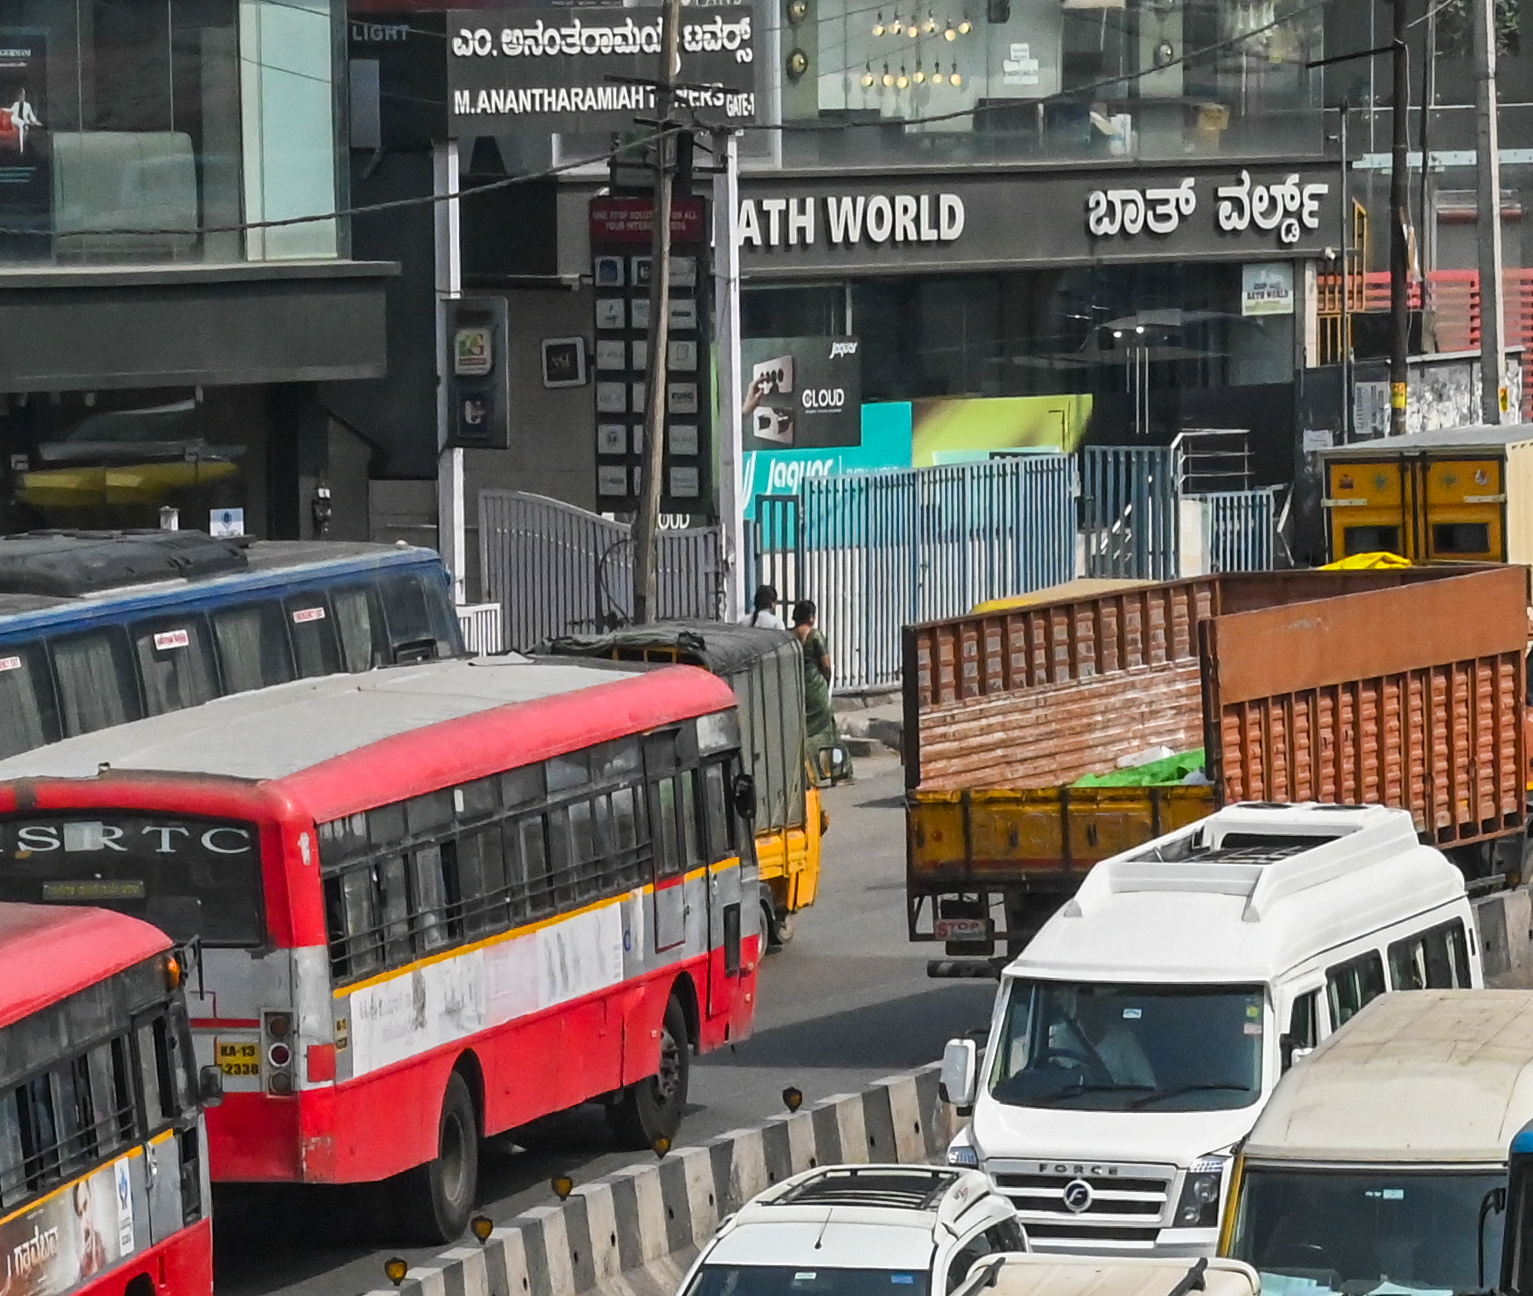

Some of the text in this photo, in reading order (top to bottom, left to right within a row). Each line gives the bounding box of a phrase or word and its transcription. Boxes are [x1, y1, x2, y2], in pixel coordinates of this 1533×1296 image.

[711, 193, 966, 248] ATH WORLD
[802, 388, 845, 408] CLOUD
[1038, 1163, 1120, 1175] FORCE
